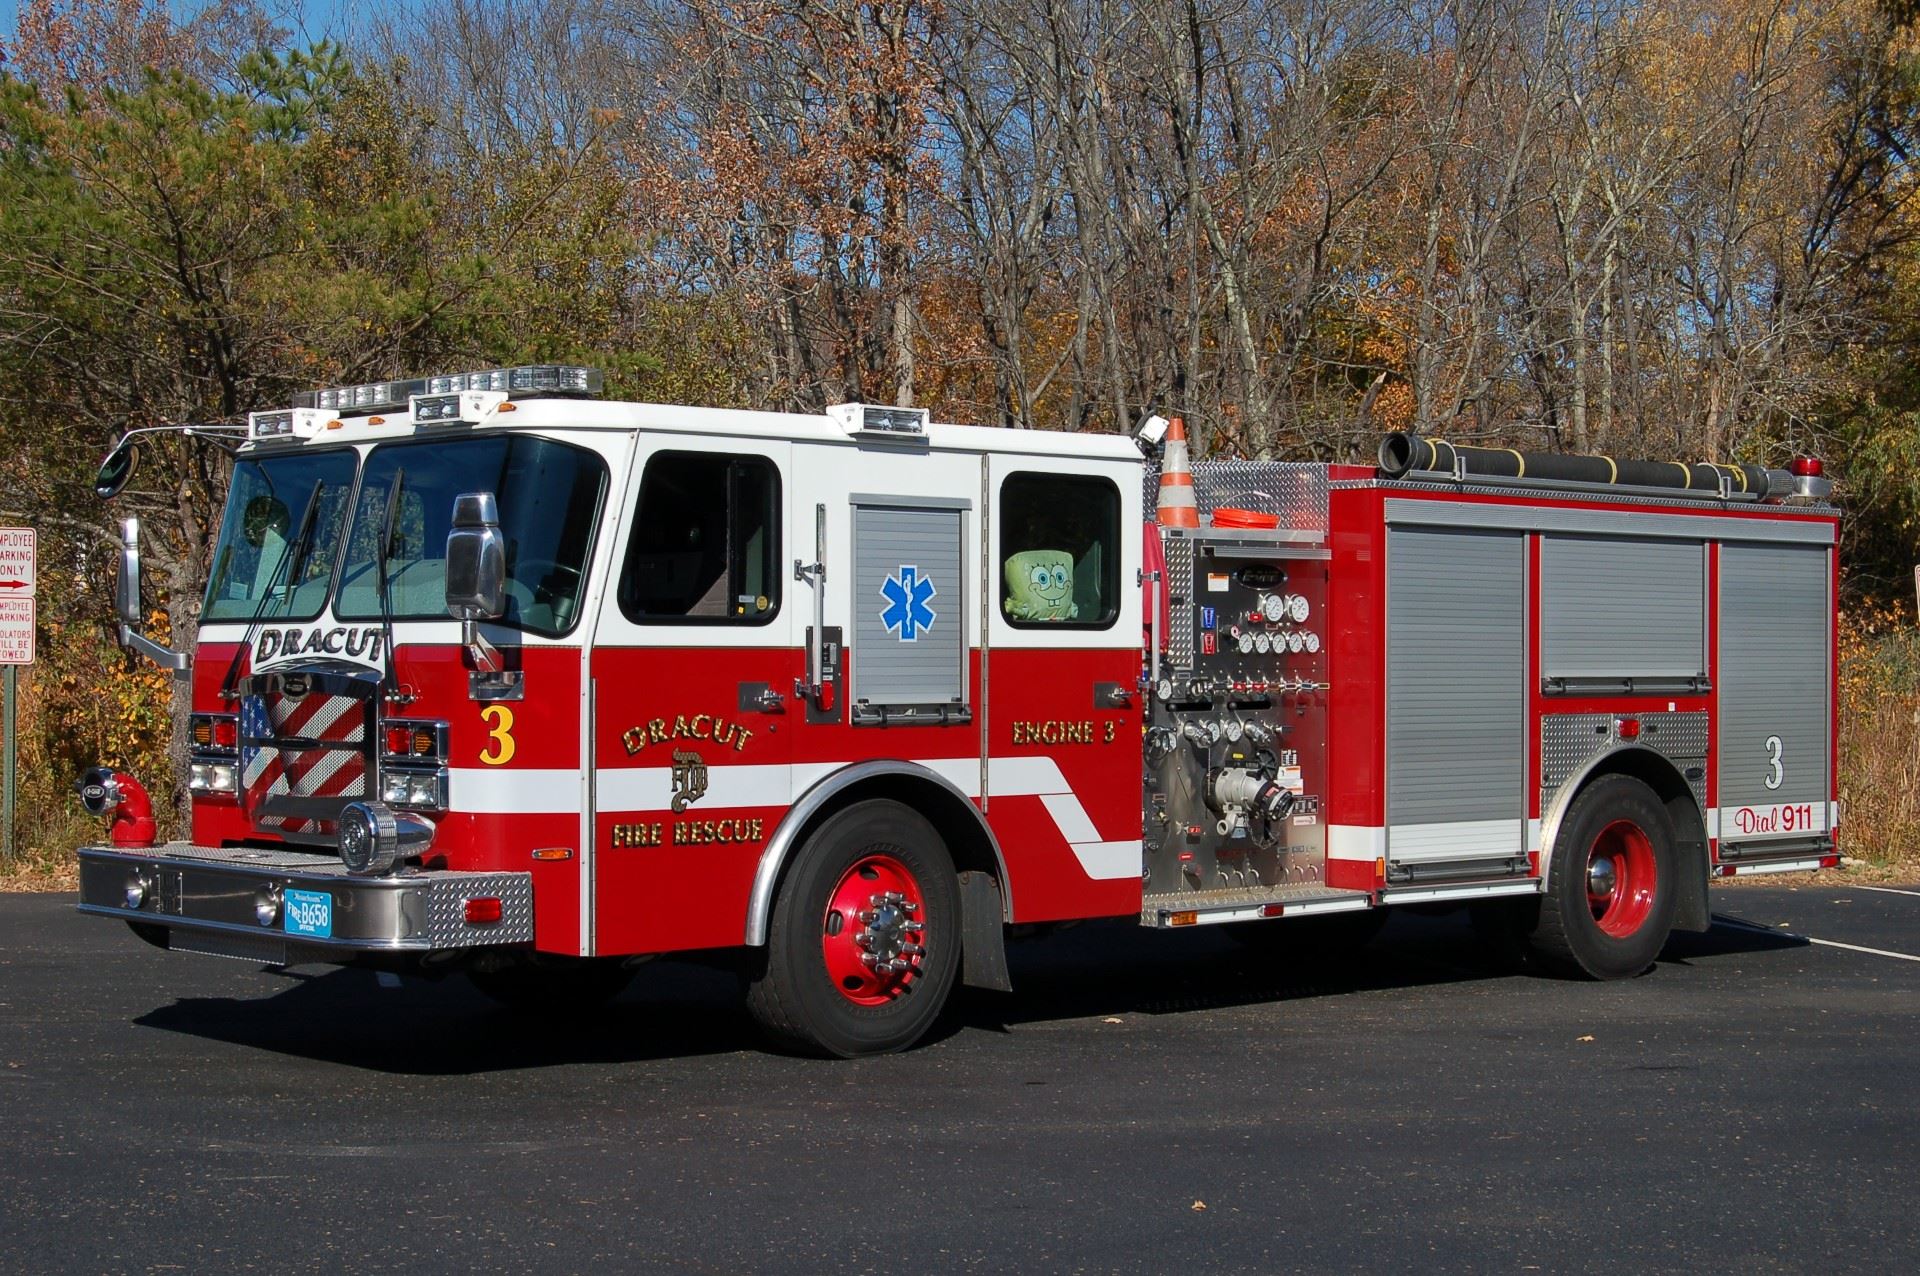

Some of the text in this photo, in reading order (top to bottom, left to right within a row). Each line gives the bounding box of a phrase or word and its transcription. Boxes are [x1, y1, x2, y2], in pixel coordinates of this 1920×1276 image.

[0, 534, 32, 547] MPLOYEE
[0, 551, 31, 562] ARKING
[0, 565, 25, 576] ONLY
[0, 602, 30, 611] MPLOYEE
[0, 613, 31, 622] ARKING
[0, 630, 31, 639] OLATORS
[0, 640, 28, 649] ILL BE
[255, 627, 385, 664] DRACUT
[479, 704, 516, 766] 3
[621, 713, 754, 757] DRACUT
[1012, 720, 1116, 744] ENGINE 3
[1764, 734, 1784, 790] 3
[1734, 804, 1812, 834] Dial 911
[612, 818, 763, 849] FIRE RESCUE
[287, 900, 328, 927] FIRE B658
